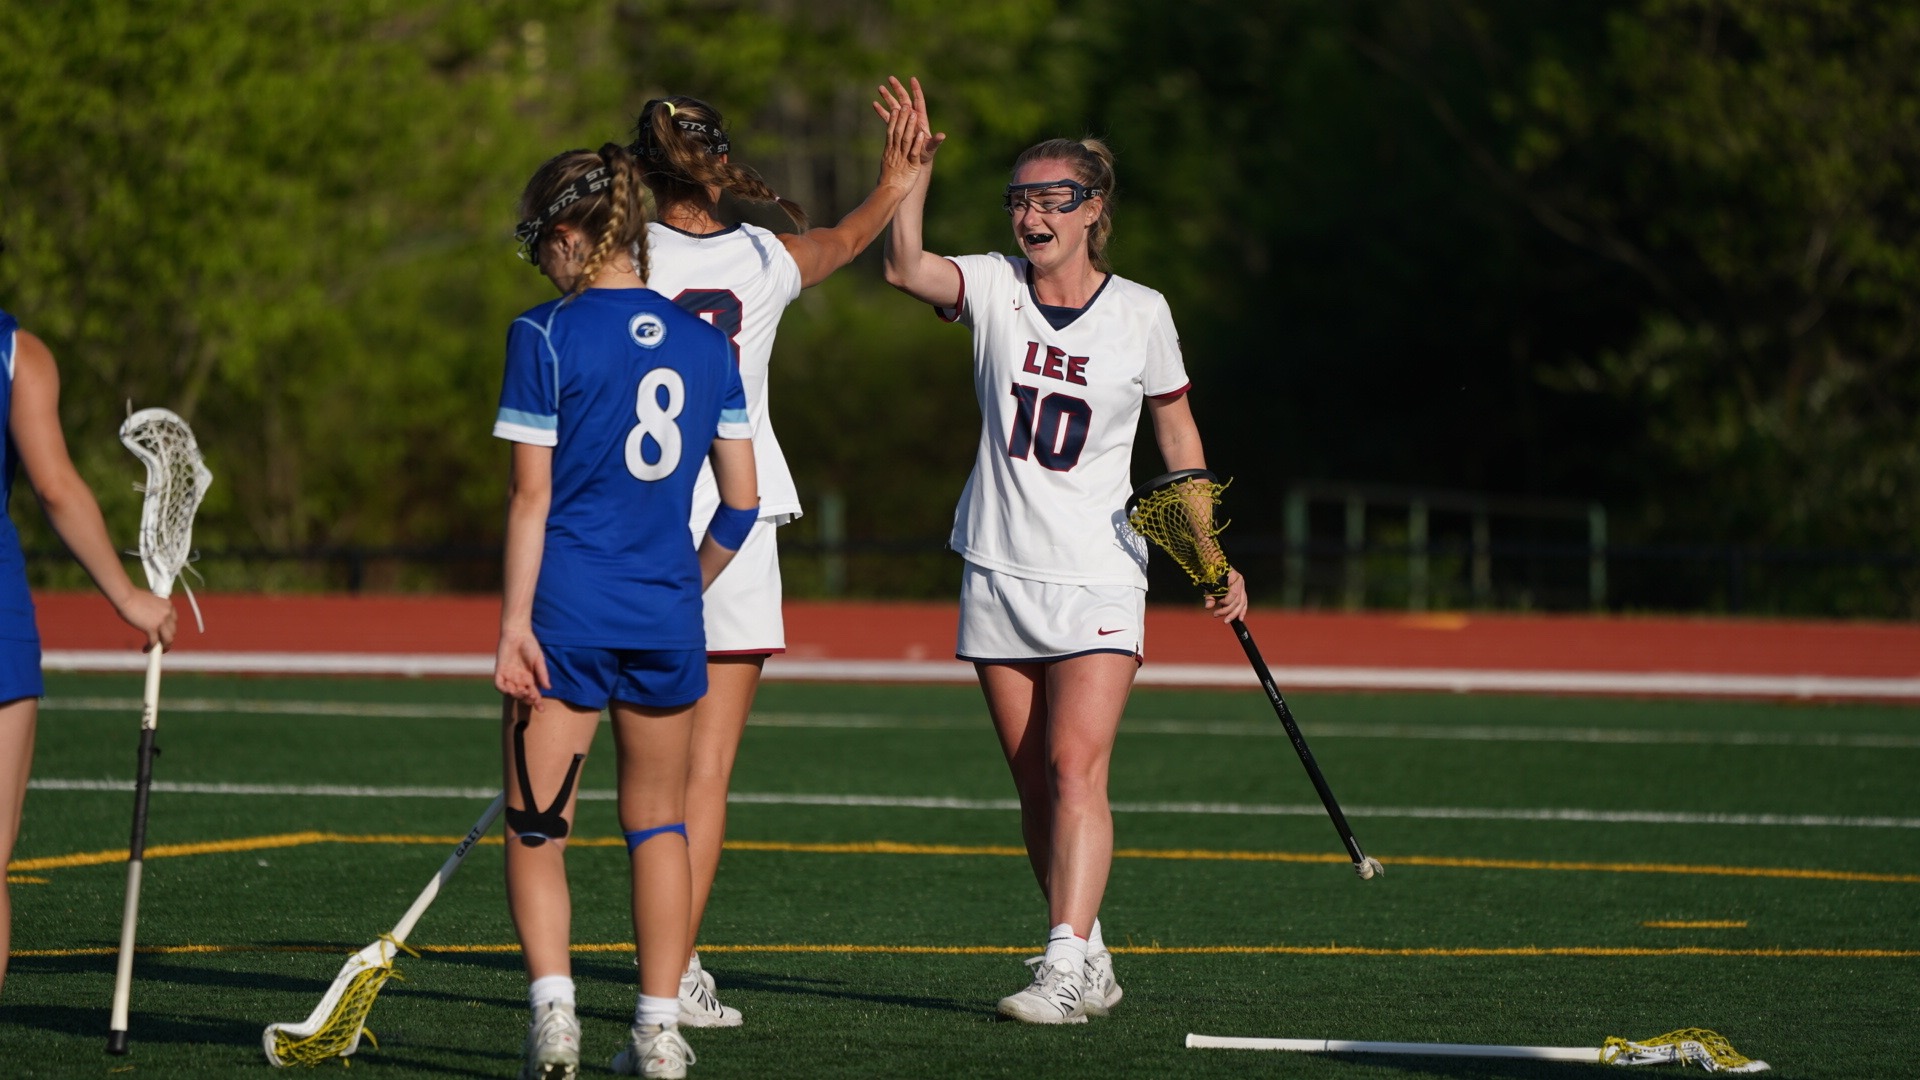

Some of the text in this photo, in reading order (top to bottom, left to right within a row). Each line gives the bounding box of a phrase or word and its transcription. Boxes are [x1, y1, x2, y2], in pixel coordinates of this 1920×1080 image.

[678, 120, 707, 133] STX
[713, 128, 723, 139] ST
[717, 143, 729, 154] STX
[585, 167, 606, 182] ST
[589, 177, 611, 193] ST
[548, 190, 581, 217] STX
[1022, 341, 1090, 387] LEE
[624, 366, 686, 482] 8
[1008, 382, 1093, 473] 10
[455, 826, 481, 858] GAIT
